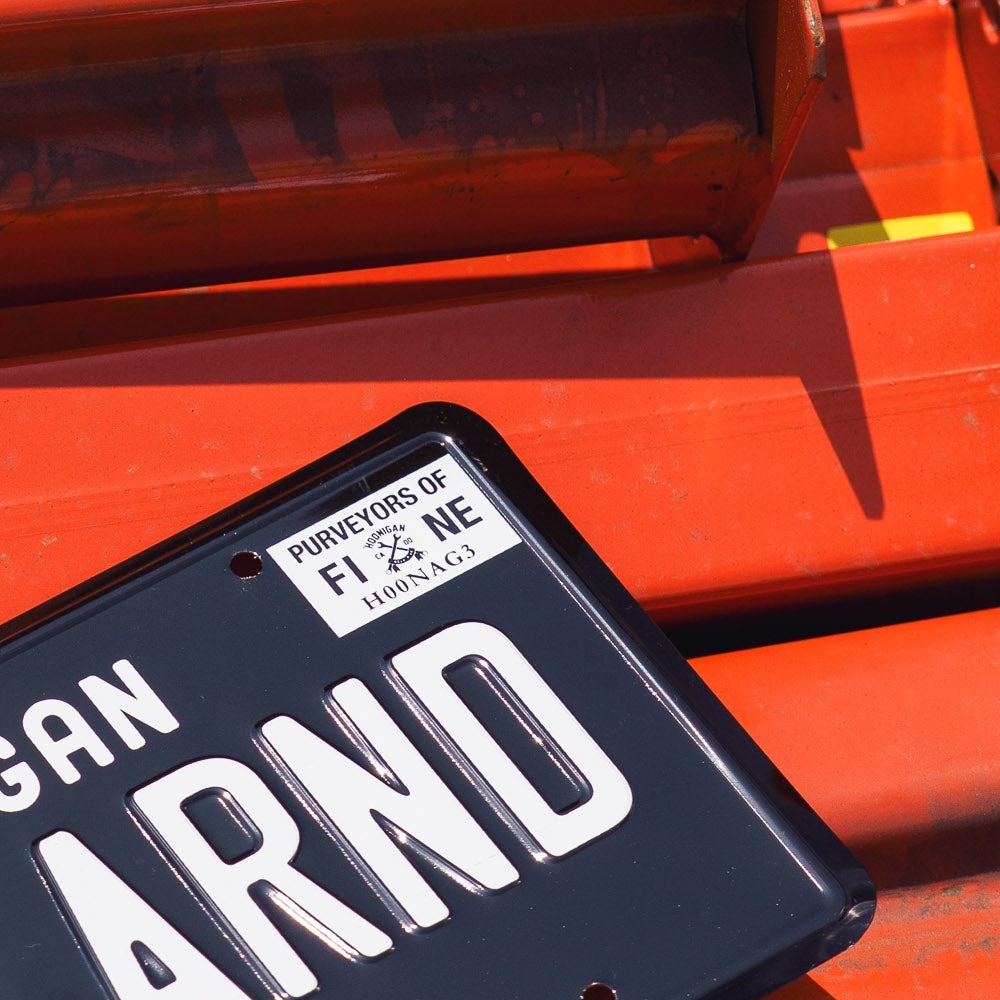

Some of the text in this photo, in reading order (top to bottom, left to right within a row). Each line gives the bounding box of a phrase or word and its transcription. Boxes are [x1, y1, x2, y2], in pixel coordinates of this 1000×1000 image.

[287, 468, 448, 564] PURVEYORS OF
[363, 524, 406, 549] HOONIGAN
[420, 495, 484, 542] NE
[317, 555, 369, 596] FI
